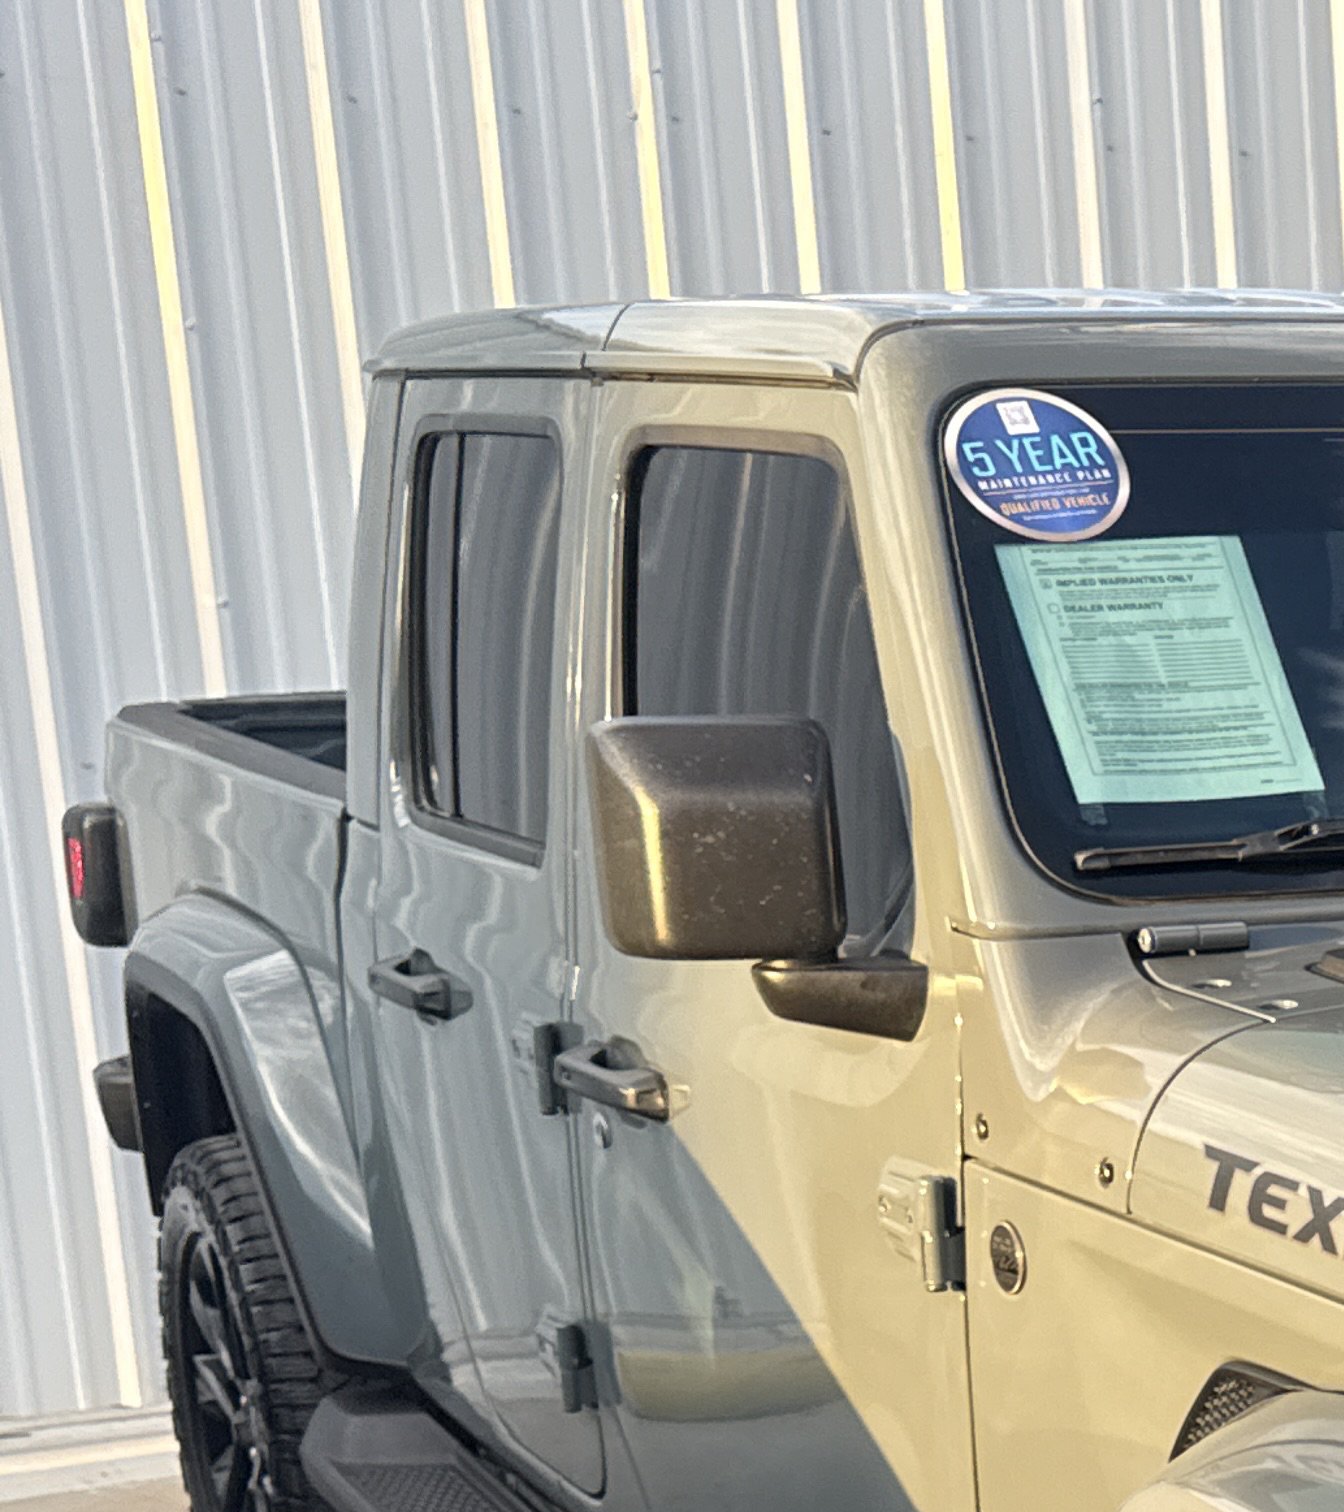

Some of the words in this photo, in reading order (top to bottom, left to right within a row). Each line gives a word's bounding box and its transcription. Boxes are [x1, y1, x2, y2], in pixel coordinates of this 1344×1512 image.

[962, 441, 996, 477] 5
[994, 431, 1105, 474] YEAR
[978, 471, 1072, 490] MAINTENANCE
[1076, 468, 1112, 481] PLAN
[1000, 498, 1060, 516] QUALIFIED
[1062, 493, 1110, 508] VEHICLE
[1056, 577, 1096, 588] IMPLIED
[1099, 575, 1166, 586] WARRANTIES
[1167, 574, 1194, 584] ONLY
[1063, 602, 1105, 613] DEALER
[1107, 601, 1164, 612] WARRANTY
